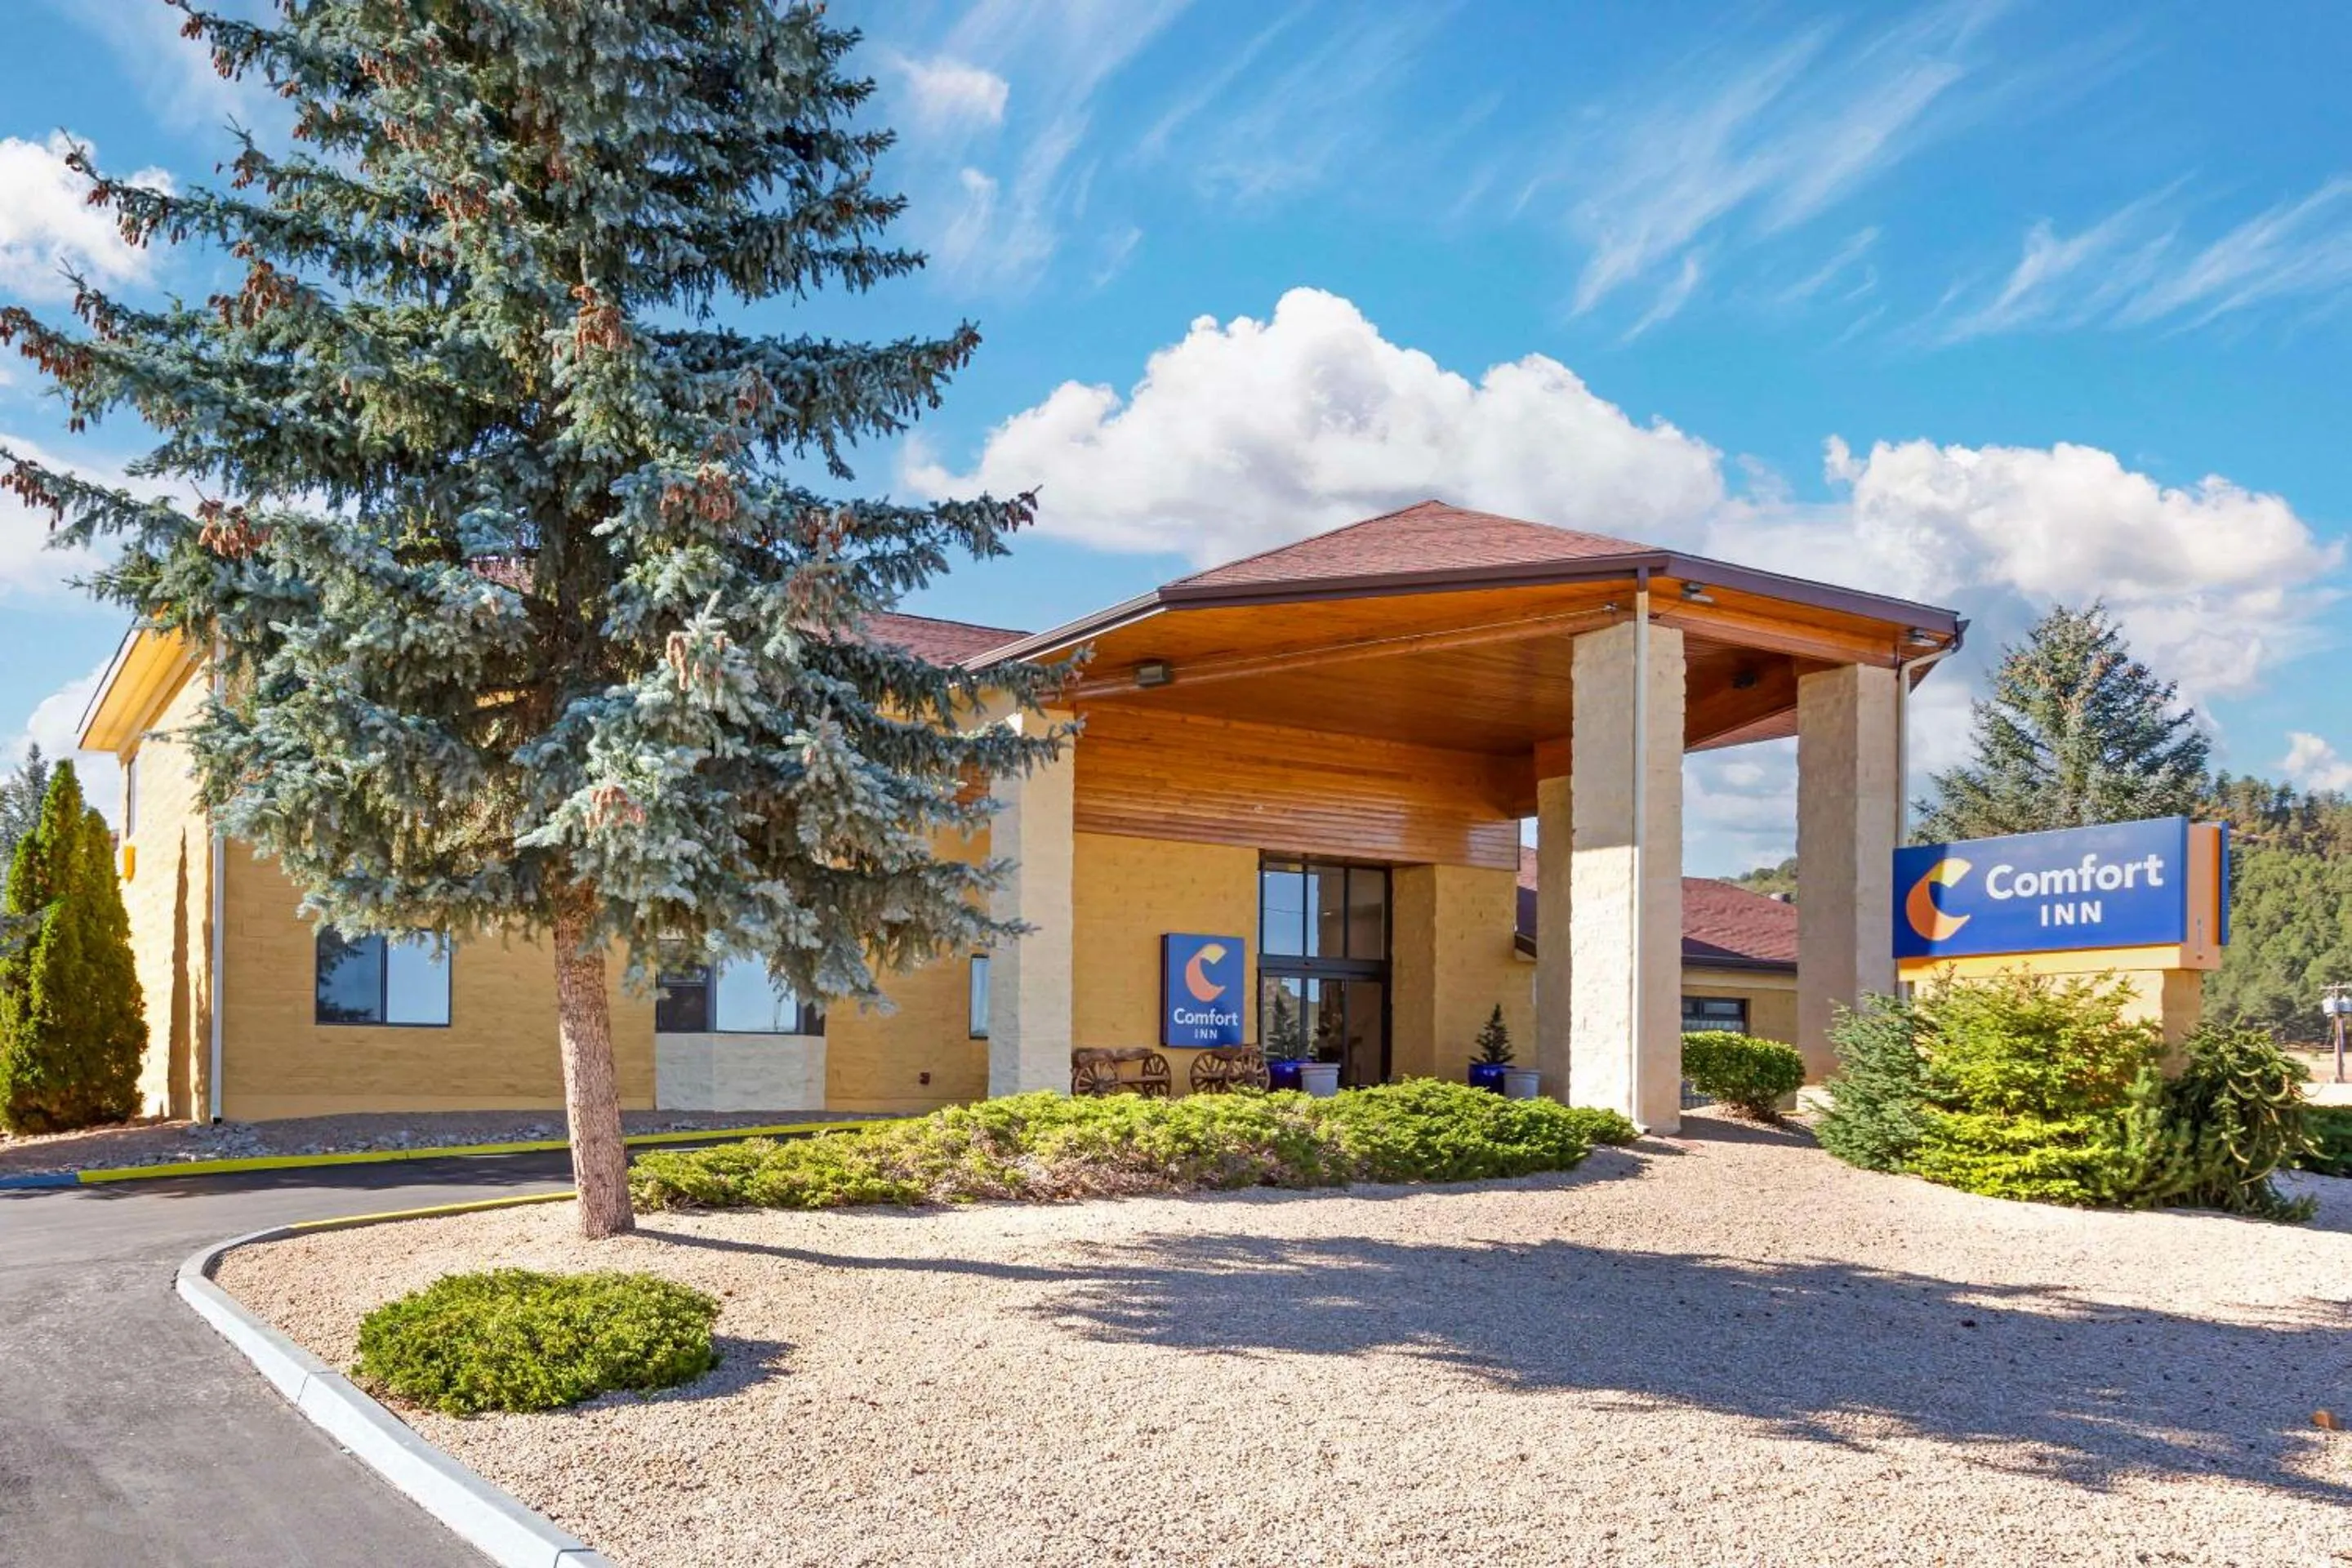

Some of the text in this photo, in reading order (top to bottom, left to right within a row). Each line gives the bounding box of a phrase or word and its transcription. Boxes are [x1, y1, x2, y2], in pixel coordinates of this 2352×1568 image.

[1985, 853, 2164, 900] Comfort
[2040, 901, 2102, 928] INN
[1174, 1007, 1239, 1027] Comfort
[1194, 1028, 1218, 1040] INN
